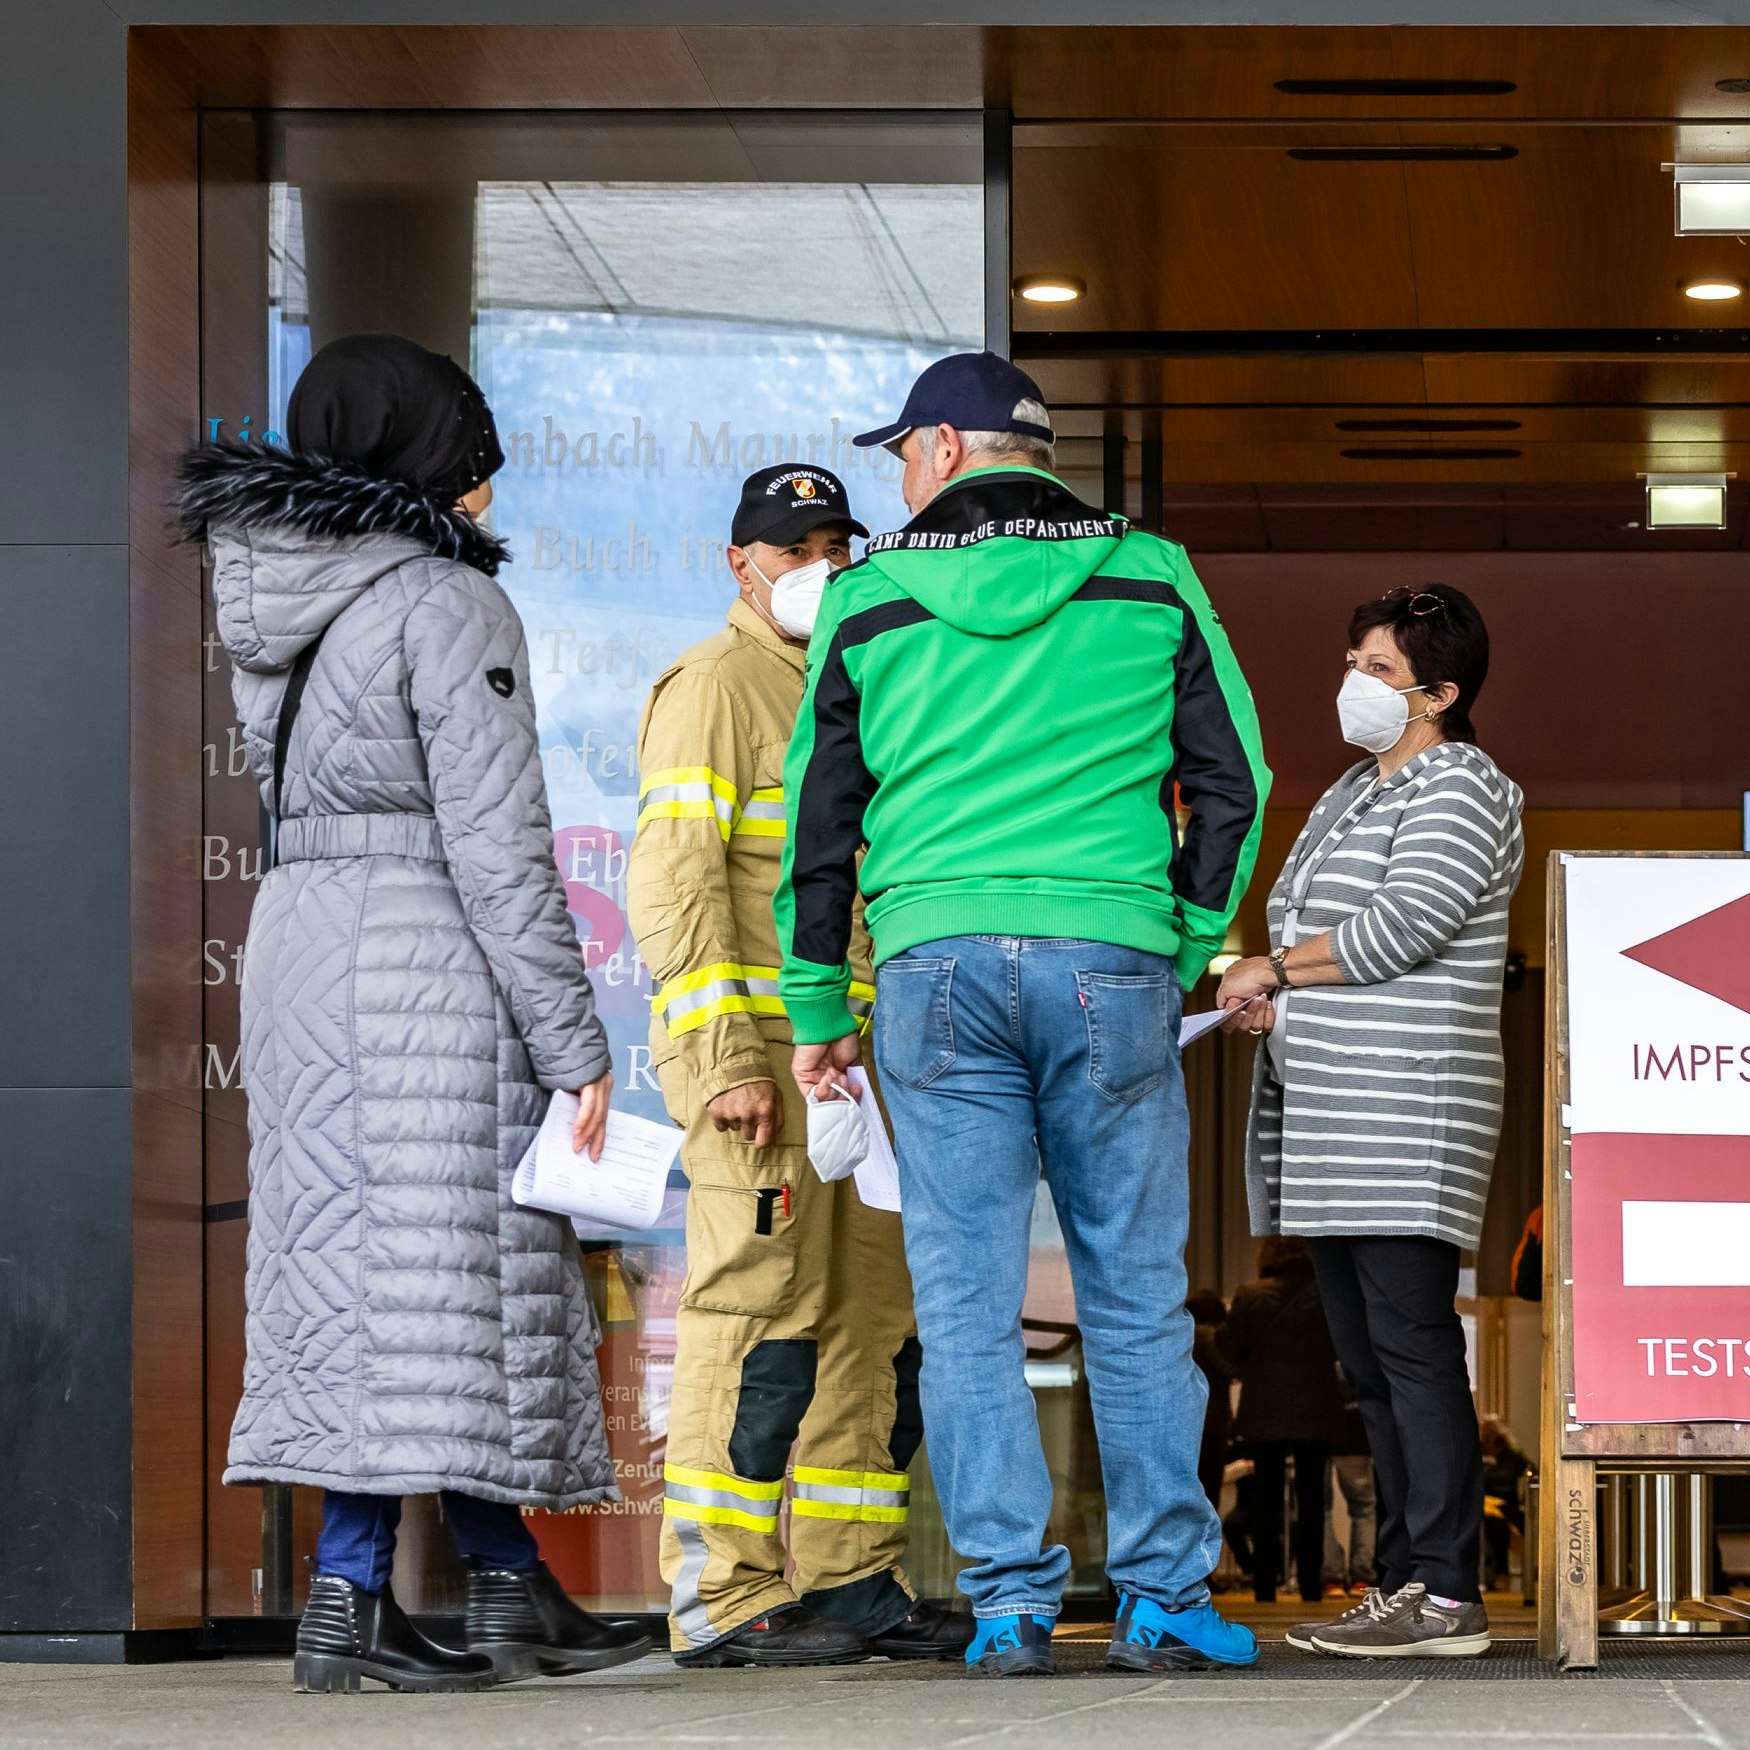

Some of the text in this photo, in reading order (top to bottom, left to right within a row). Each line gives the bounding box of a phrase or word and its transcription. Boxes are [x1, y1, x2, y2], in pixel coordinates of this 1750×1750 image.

[766, 470, 838, 495] FEUERWEHR
[791, 498, 829, 508] SCHWAZ
[532, 520, 655, 571] Buch
[868, 532, 904, 553] CAMP
[907, 532, 957, 549] DAVID
[1005, 518, 1114, 538] DEPARTMENT
[1568, 1489, 1588, 1564] schwaz
